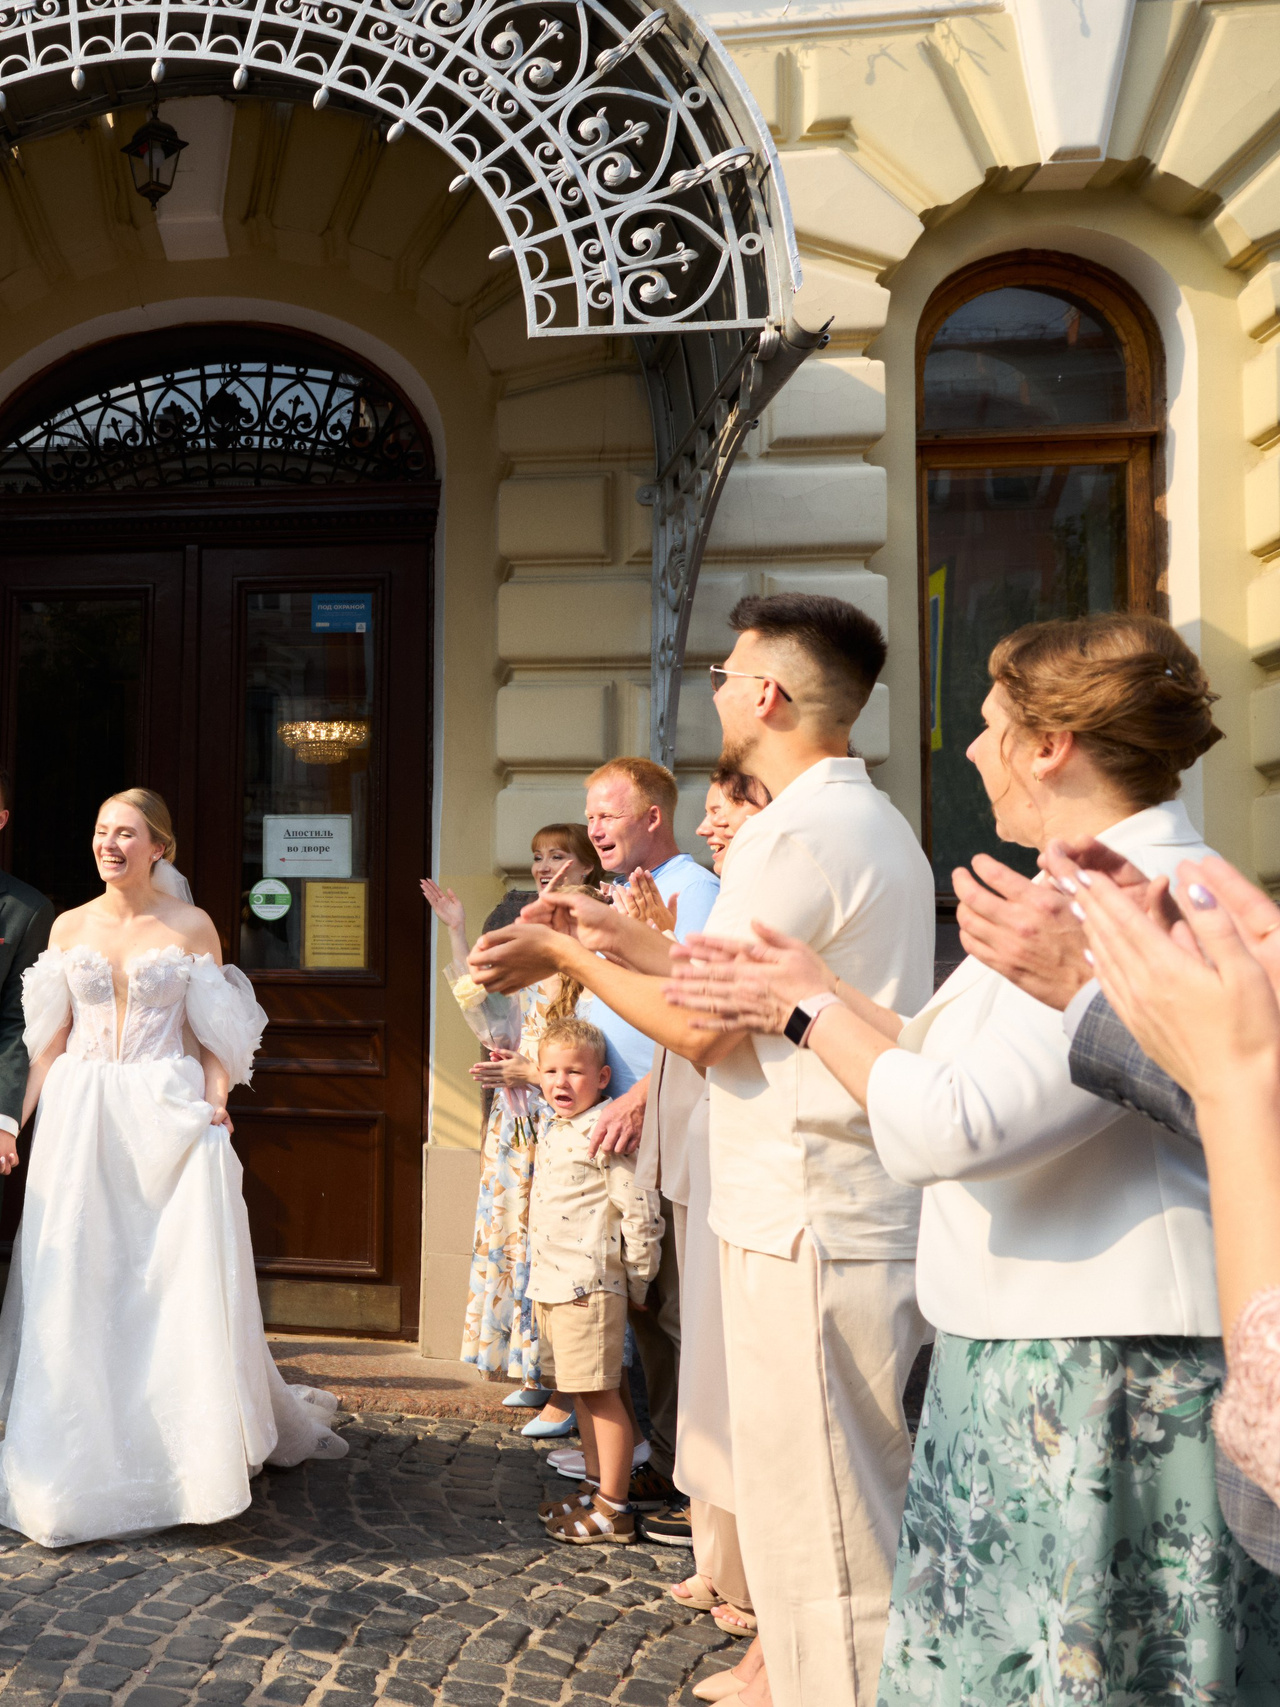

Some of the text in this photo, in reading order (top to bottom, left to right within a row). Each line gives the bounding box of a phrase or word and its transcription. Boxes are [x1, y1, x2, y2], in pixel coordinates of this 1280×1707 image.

[283, 828, 334, 838] Апостиль
[287, 845, 330, 854] во дворе
